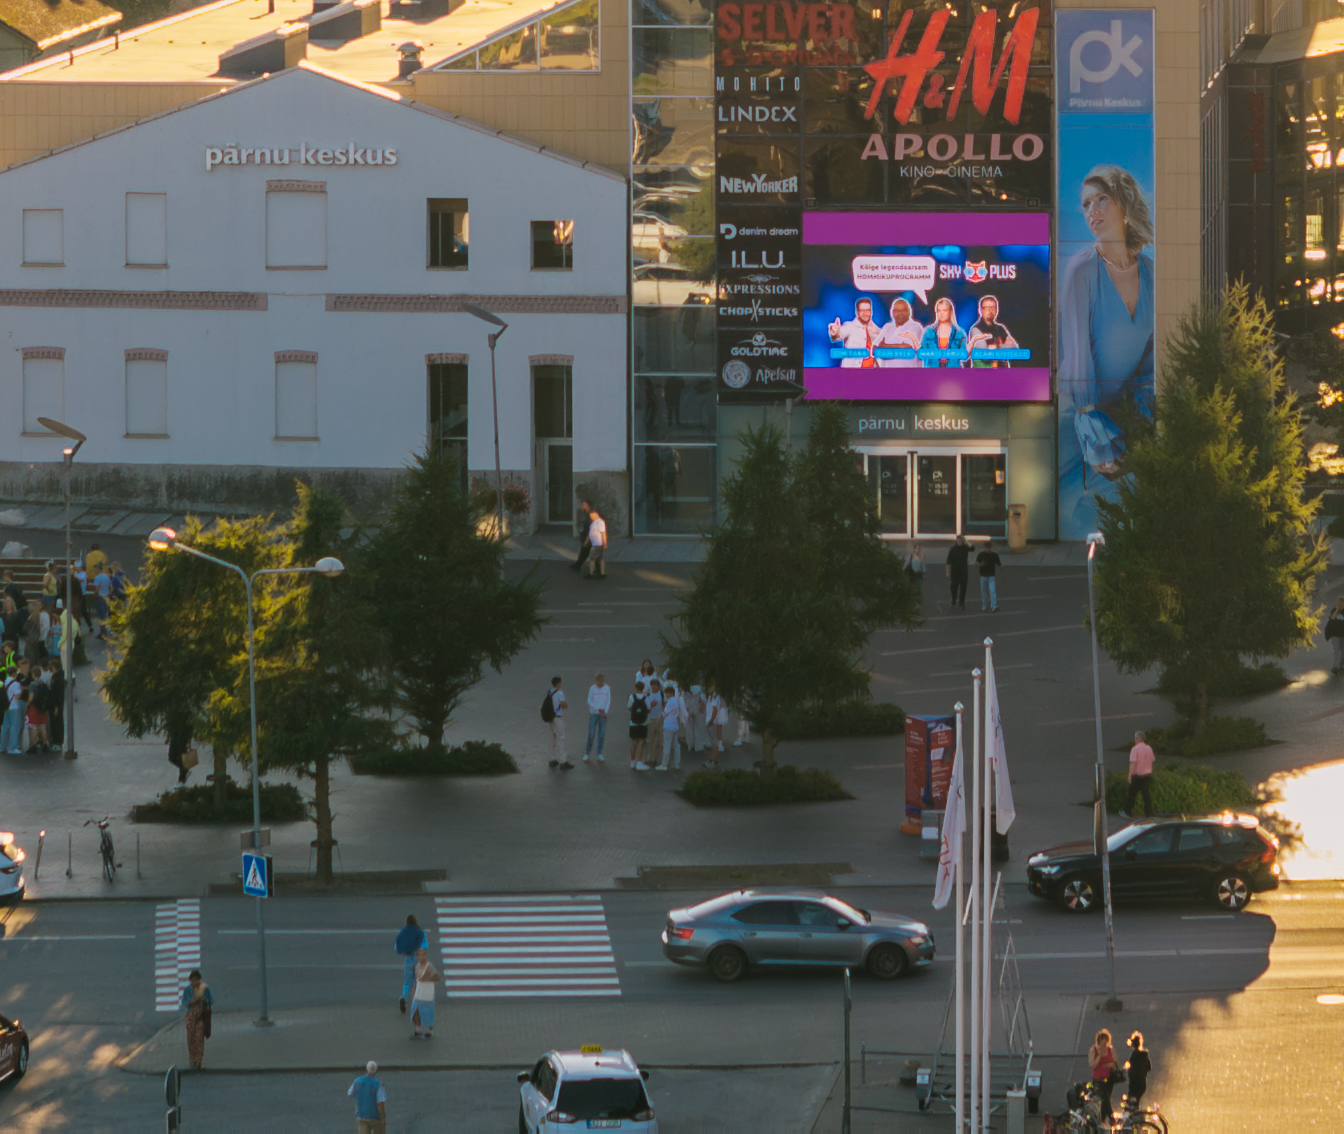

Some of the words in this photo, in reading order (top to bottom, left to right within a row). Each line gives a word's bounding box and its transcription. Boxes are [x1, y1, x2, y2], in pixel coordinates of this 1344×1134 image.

[716, 0, 858, 42] SELVER
[863, 6, 1040, 126] H&M
[716, 76, 800, 92] MOHITO
[718, 105, 798, 122] LINDEX
[860, 133, 1044, 161] APOLLO
[206, 142, 290, 172] pärnu
[300, 142, 397, 166] keskus
[738, 226, 767, 236] denim
[769, 226, 799, 236] dream
[939, 264, 962, 279] SKY
[989, 264, 1017, 279] PLUS
[718, 284, 801, 295] EXPRESSIONS
[730, 346, 788, 357] GOLDTIME
[755, 366, 796, 385] Apelsin
[858, 416, 905, 433] pärnu
[914, 414, 969, 430] keskus
